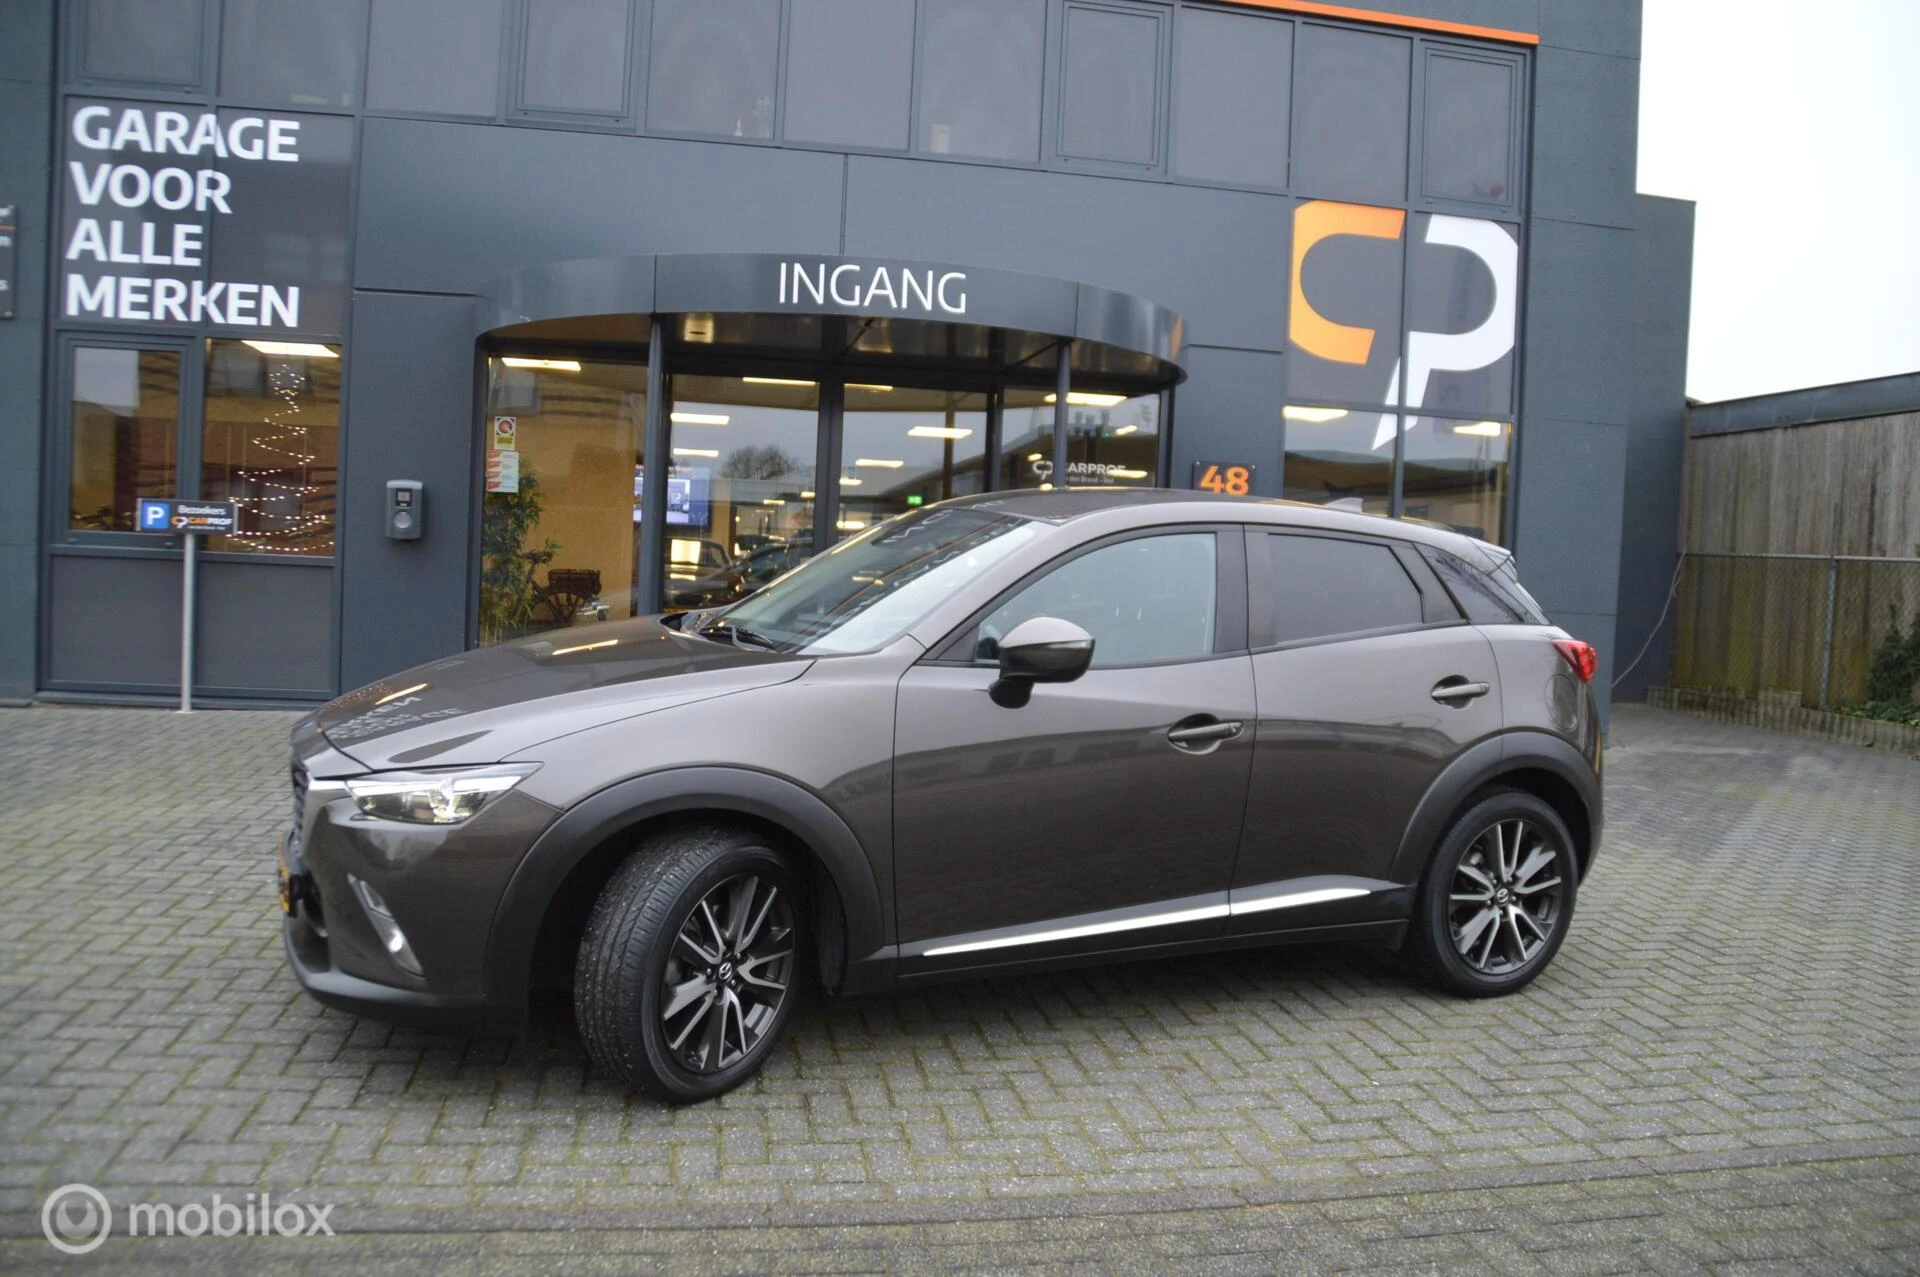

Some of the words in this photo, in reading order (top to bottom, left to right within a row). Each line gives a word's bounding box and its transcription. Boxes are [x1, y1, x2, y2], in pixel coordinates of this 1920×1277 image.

[72, 105, 300, 162] GARAGE
[69, 161, 233, 214] VOOR
[66, 218, 204, 266] ALLE
[65, 274, 299, 328] MERKEN
[778, 262, 967, 314] INGANG
[1066, 462, 1127, 477] ARPROF
[1200, 465, 1250, 496] 48
[146, 506, 165, 526] P
